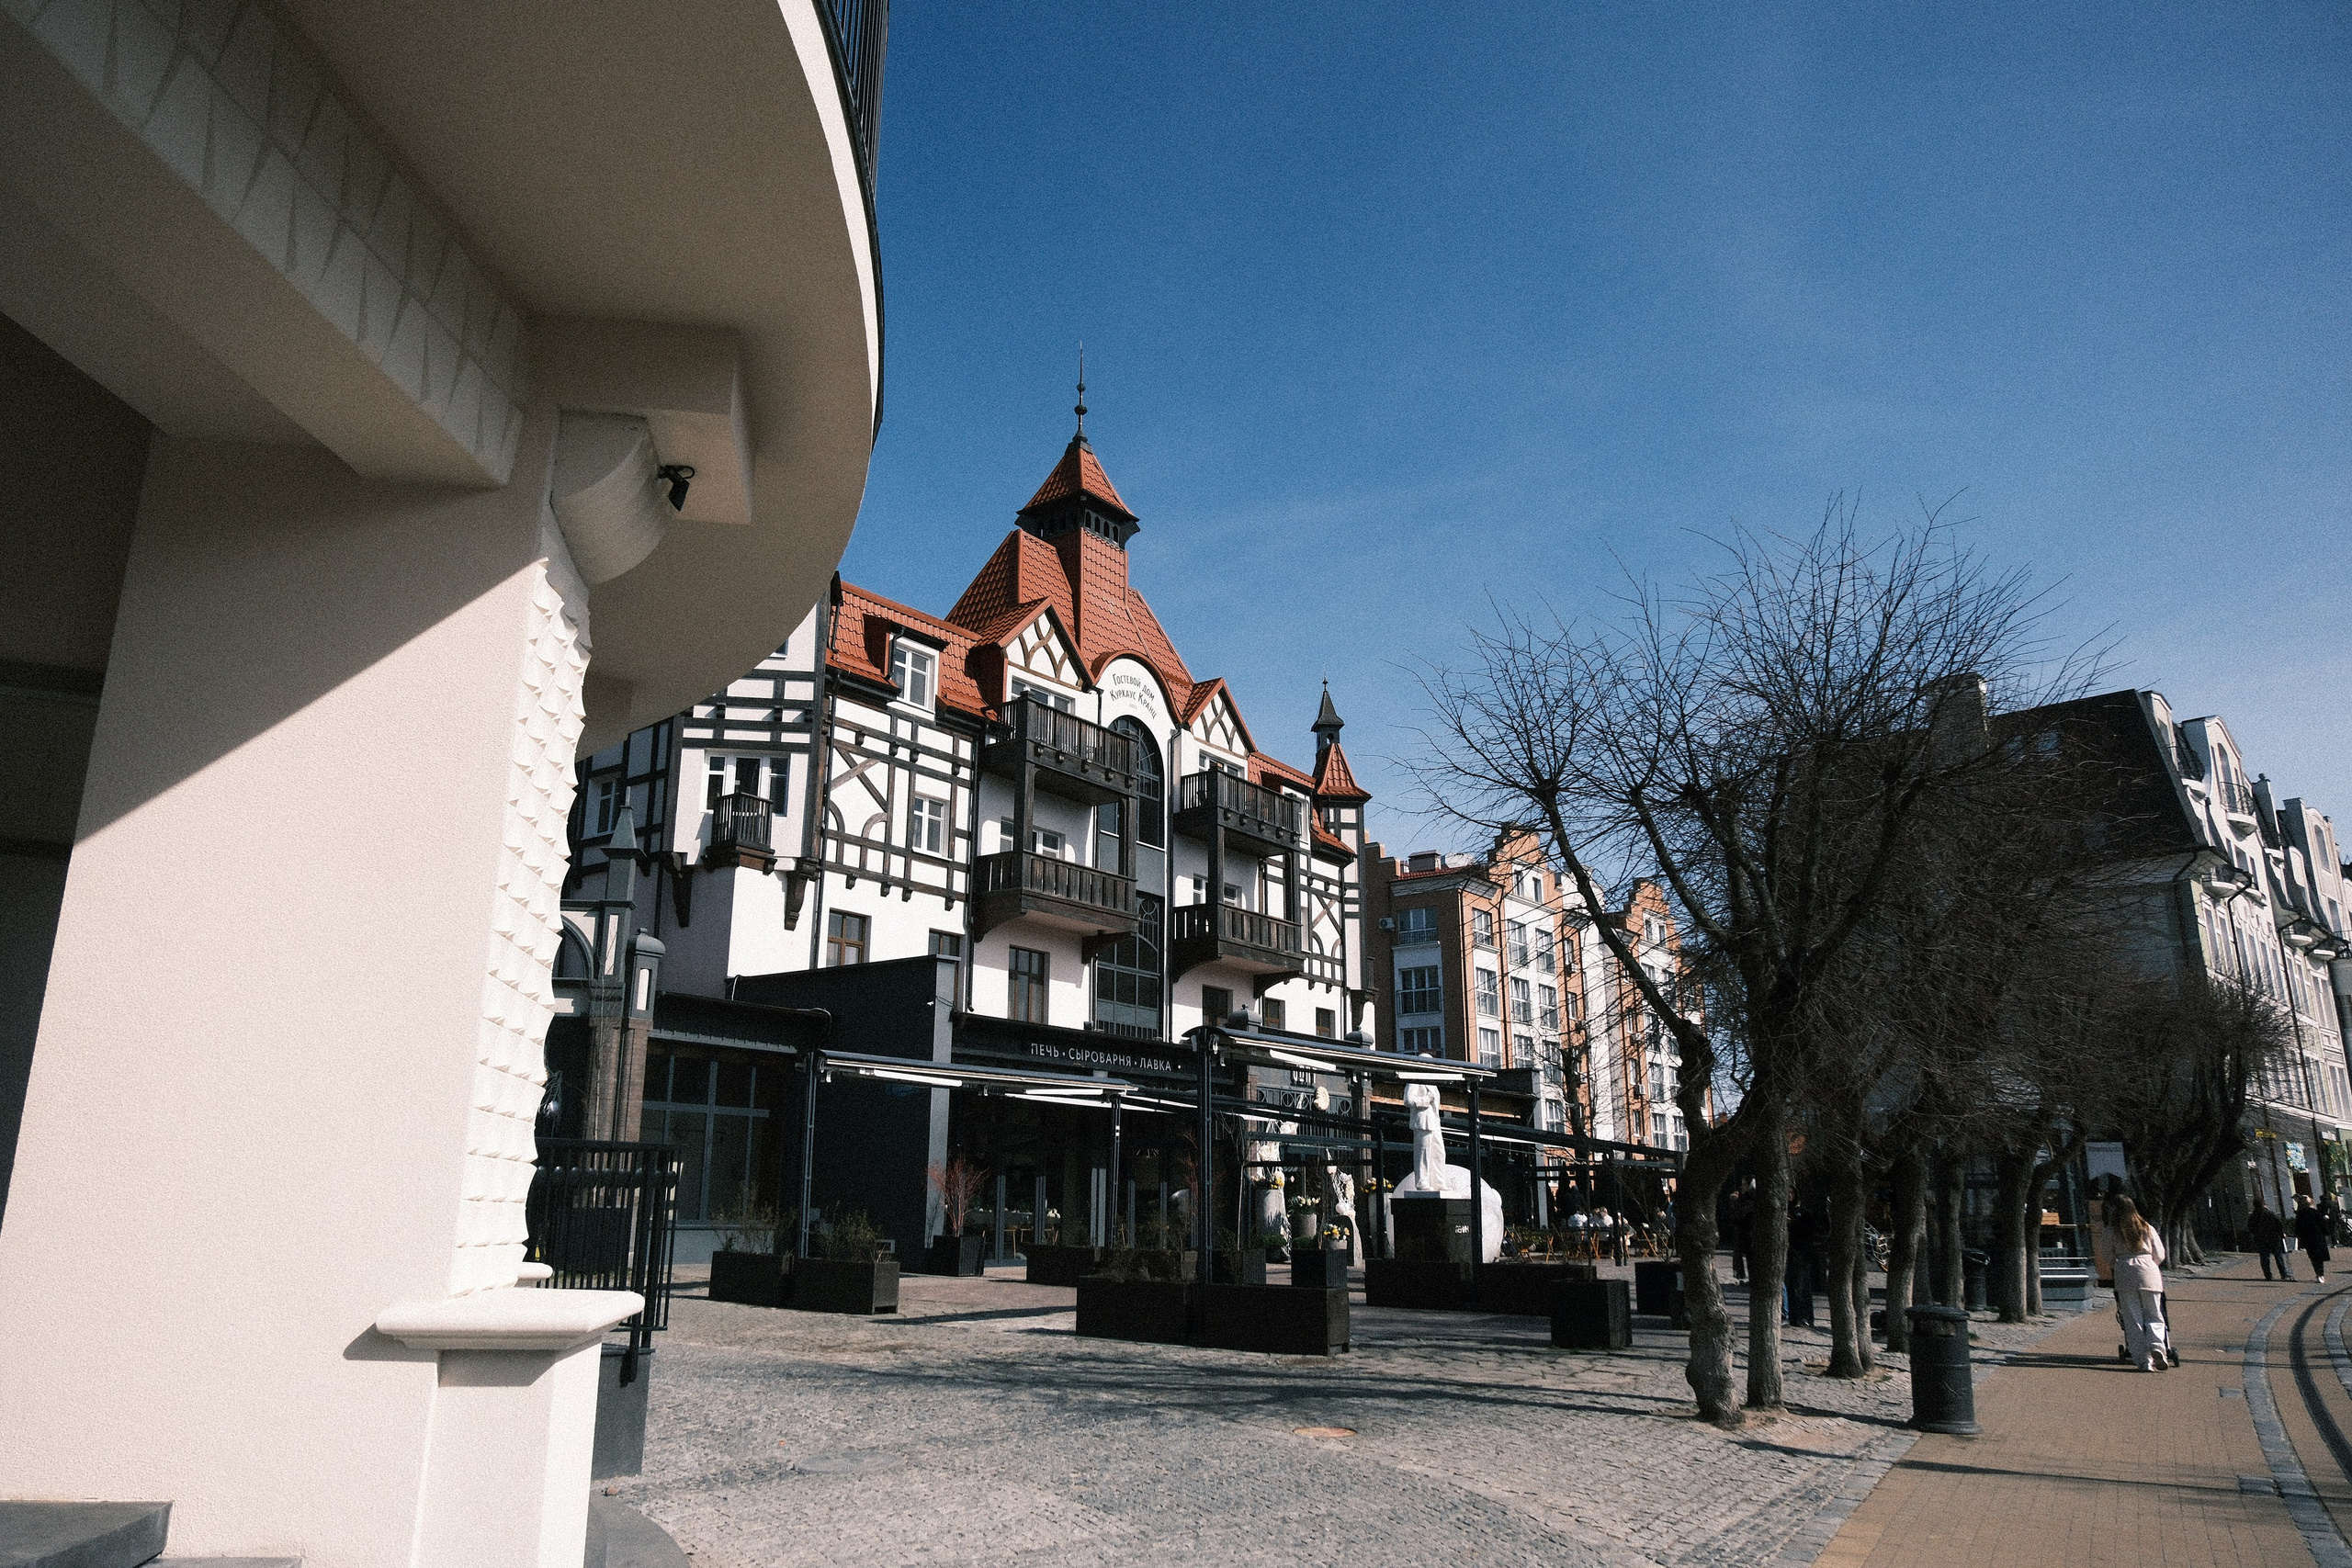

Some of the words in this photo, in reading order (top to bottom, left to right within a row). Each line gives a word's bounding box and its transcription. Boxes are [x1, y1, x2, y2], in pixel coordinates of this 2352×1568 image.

[1031, 1043, 1059, 1058] ПЕЧЬ
[1069, 1047, 1132, 1067] СЫРОВАРНЯ
[1139, 1057, 1171, 1072] ЛАВКА
